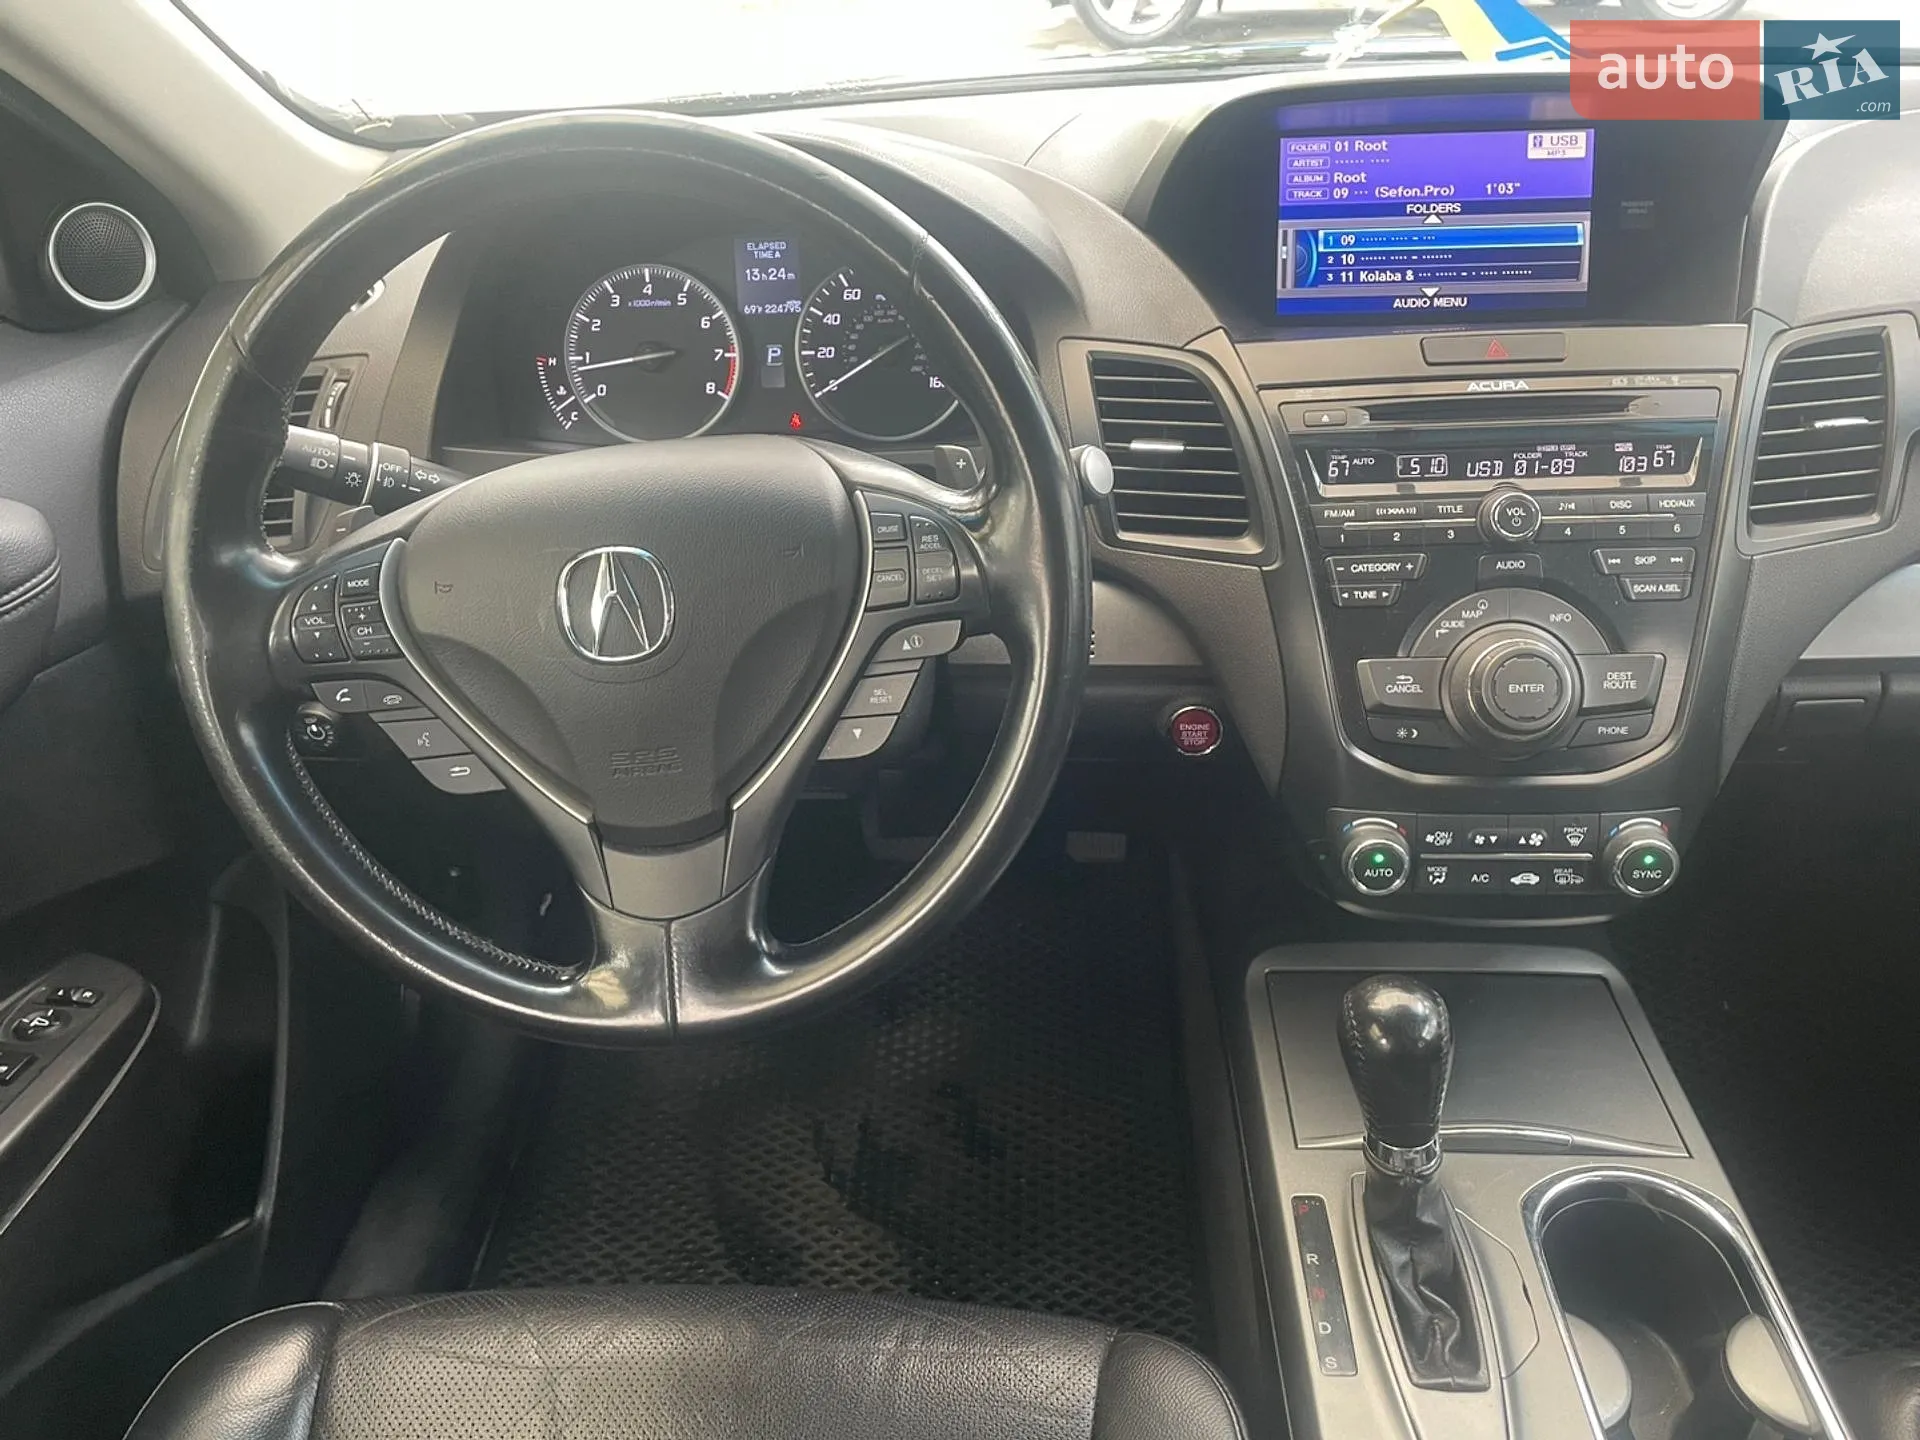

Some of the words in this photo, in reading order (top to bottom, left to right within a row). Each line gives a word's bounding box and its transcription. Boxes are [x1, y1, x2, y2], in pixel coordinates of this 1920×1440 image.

[1291, 142, 1327, 151] FOLDER
[1334, 141, 1349, 152] 01
[1354, 139, 1388, 151] Root
[1550, 135, 1579, 147] USB
[1292, 158, 1325, 168] ARTIST
[1293, 173, 1324, 183] ALBUM
[1333, 171, 1368, 183] Root
[1292, 189, 1323, 198] TRACK
[1333, 187, 1349, 199] 09
[1375, 184, 1455, 199] (Sefon.Pro)
[1406, 202, 1462, 214] FOLDERS
[1327, 236, 1334, 246] 1
[1340, 234, 1356, 246] 09
[746, 241, 787, 251] ELAPSED
[753, 250, 774, 259] TIME
[1327, 255, 1335, 264] 2
[1340, 253, 1355, 265] 10
[1326, 273, 1334, 282] 3
[1340, 271, 1354, 283] 11
[1359, 270, 1402, 283] Kolaba
[1405, 269, 1415, 281] &
[642, 283, 653, 296] 4
[843, 288, 862, 301] 60
[610, 295, 620, 308] 3
[676, 293, 688, 306] 5
[1393, 298, 1430, 309] AUDIO
[1434, 296, 1468, 308] MENU
[700, 316, 711, 329] 6
[822, 312, 841, 326] 40
[590, 318, 601, 332] 2
[584, 351, 590, 364] 1
[714, 349, 724, 362] 7
[767, 346, 782, 364] P
[816, 346, 835, 359] 20
[548, 356, 557, 367] H
[597, 384, 607, 397] 0
[705, 382, 715, 394] 8
[1466, 379, 1530, 393] ACURA
[570, 410, 579, 422] C
[302, 445, 331, 458] AUTO
[1513, 451, 1543, 460] FOLDER
[1352, 458, 1375, 466] AUTO
[1653, 450, 1675, 468] 67
[382, 462, 402, 474] OFF
[1327, 460, 1350, 478] 67
[1610, 500, 1633, 510] DISC
[1658, 499, 1696, 508] HDD/AUX
[1324, 509, 1356, 518] FM/AM
[1437, 505, 1464, 514] TITLE
[1506, 507, 1527, 516] VOL
[876, 525, 899, 534] CRUISE
[1563, 526, 1573, 537] 4
[1618, 525, 1627, 535] 5
[1673, 523, 1681, 533] 6
[1339, 533, 1345, 544] 1
[1392, 531, 1401, 542] 2
[1446, 529, 1456, 540] 3
[920, 542, 941, 550] ACCEL
[1496, 560, 1526, 571] AUDIO
[1634, 556, 1657, 566] SKIP
[1350, 561, 1402, 573] CATEGORY
[347, 578, 370, 588] MODE
[876, 574, 904, 583] CANCEL
[1633, 583, 1657, 593] SCAN
[1658, 583, 1682, 593] A.SEL
[1353, 589, 1378, 600] TUNE
[1462, 609, 1484, 619] MAP
[1549, 612, 1572, 623] INFO
[304, 615, 327, 625] VOL
[1440, 620, 1465, 629] GUIDE
[357, 626, 373, 636] CH
[1606, 671, 1634, 681] DEST
[1385, 684, 1424, 694] CANCEL
[1508, 683, 1545, 694] ENTER
[1603, 680, 1637, 690] ROUTE
[1179, 723, 1211, 731] ENGINE
[1597, 726, 1630, 736] PHONE
[1563, 826, 1589, 834] FRONT
[1363, 868, 1394, 878] AUTO
[1470, 873, 1490, 884] A/C
[1632, 869, 1663, 880] SYNC
[1306, 1253, 1320, 1266] R
[1318, 1321, 1332, 1335] D
[1324, 1356, 1338, 1370] S
